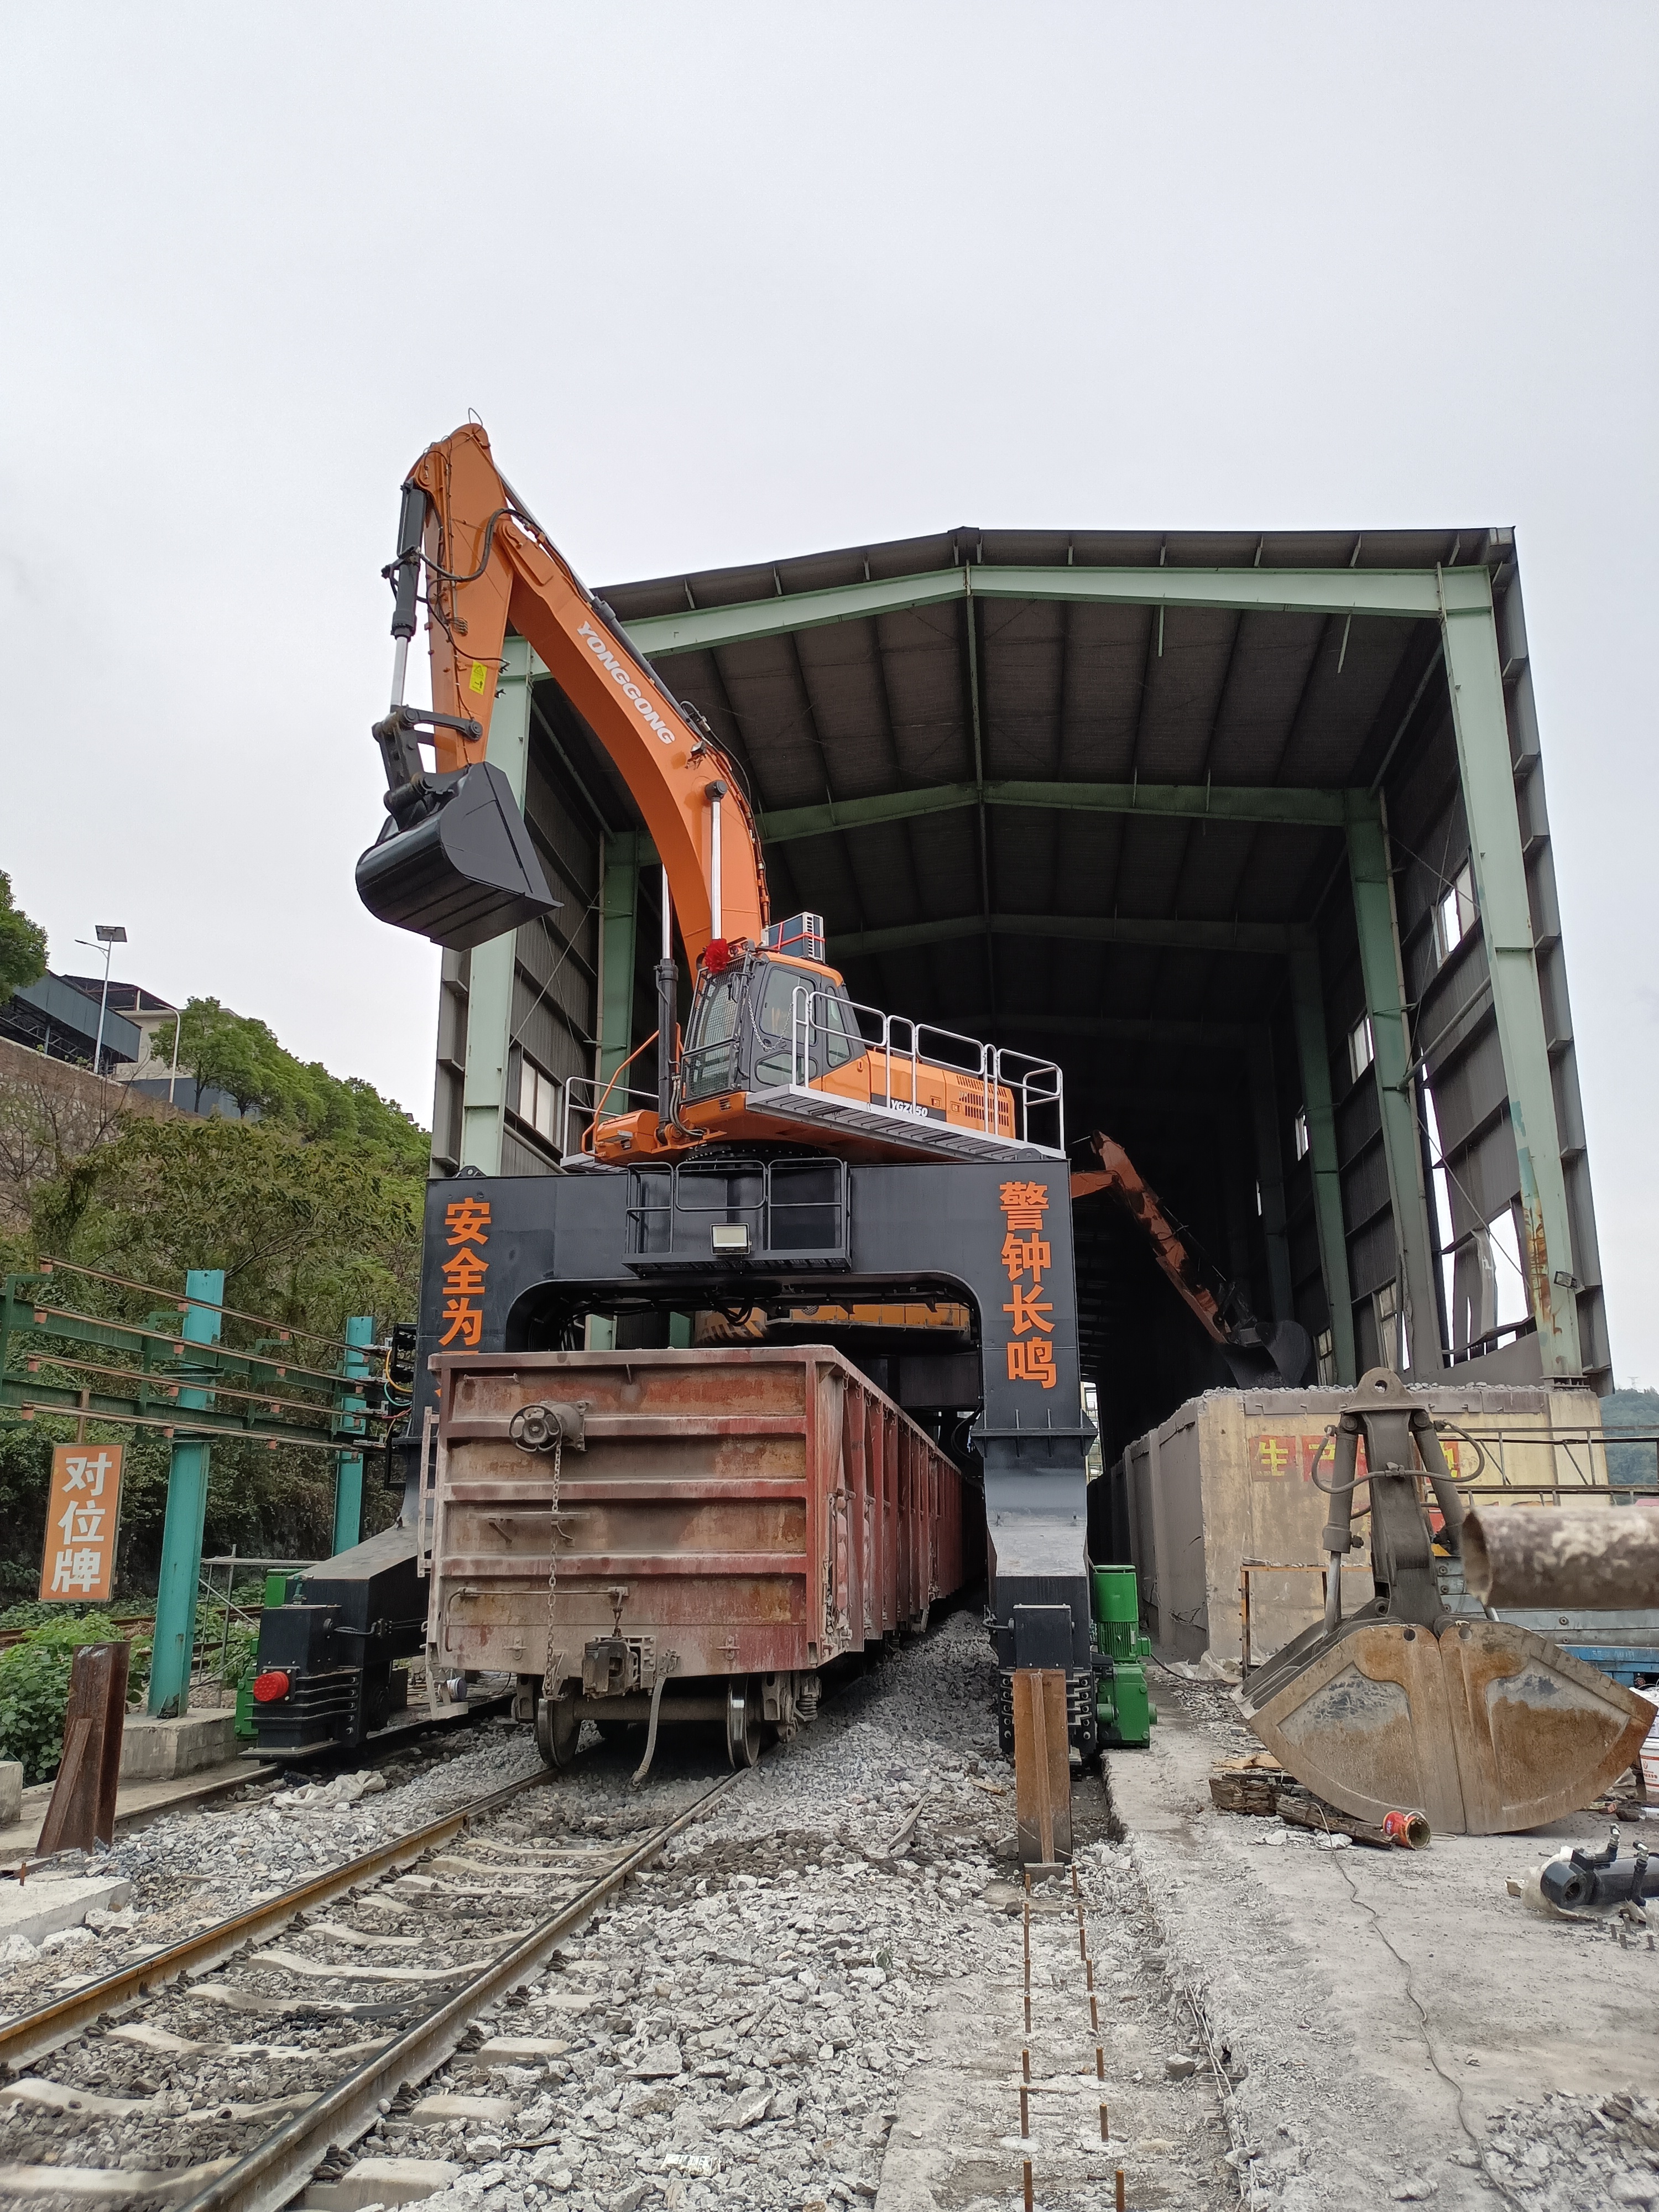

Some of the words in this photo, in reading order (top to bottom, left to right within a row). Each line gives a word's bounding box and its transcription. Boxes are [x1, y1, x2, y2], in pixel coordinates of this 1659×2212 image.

[577, 620, 675, 744] YONGGONG
[435, 1197, 492, 1397] 安全为
[999, 1181, 1057, 1389] 警钟长鸣
[50, 1452, 112, 1593] 对位牌
